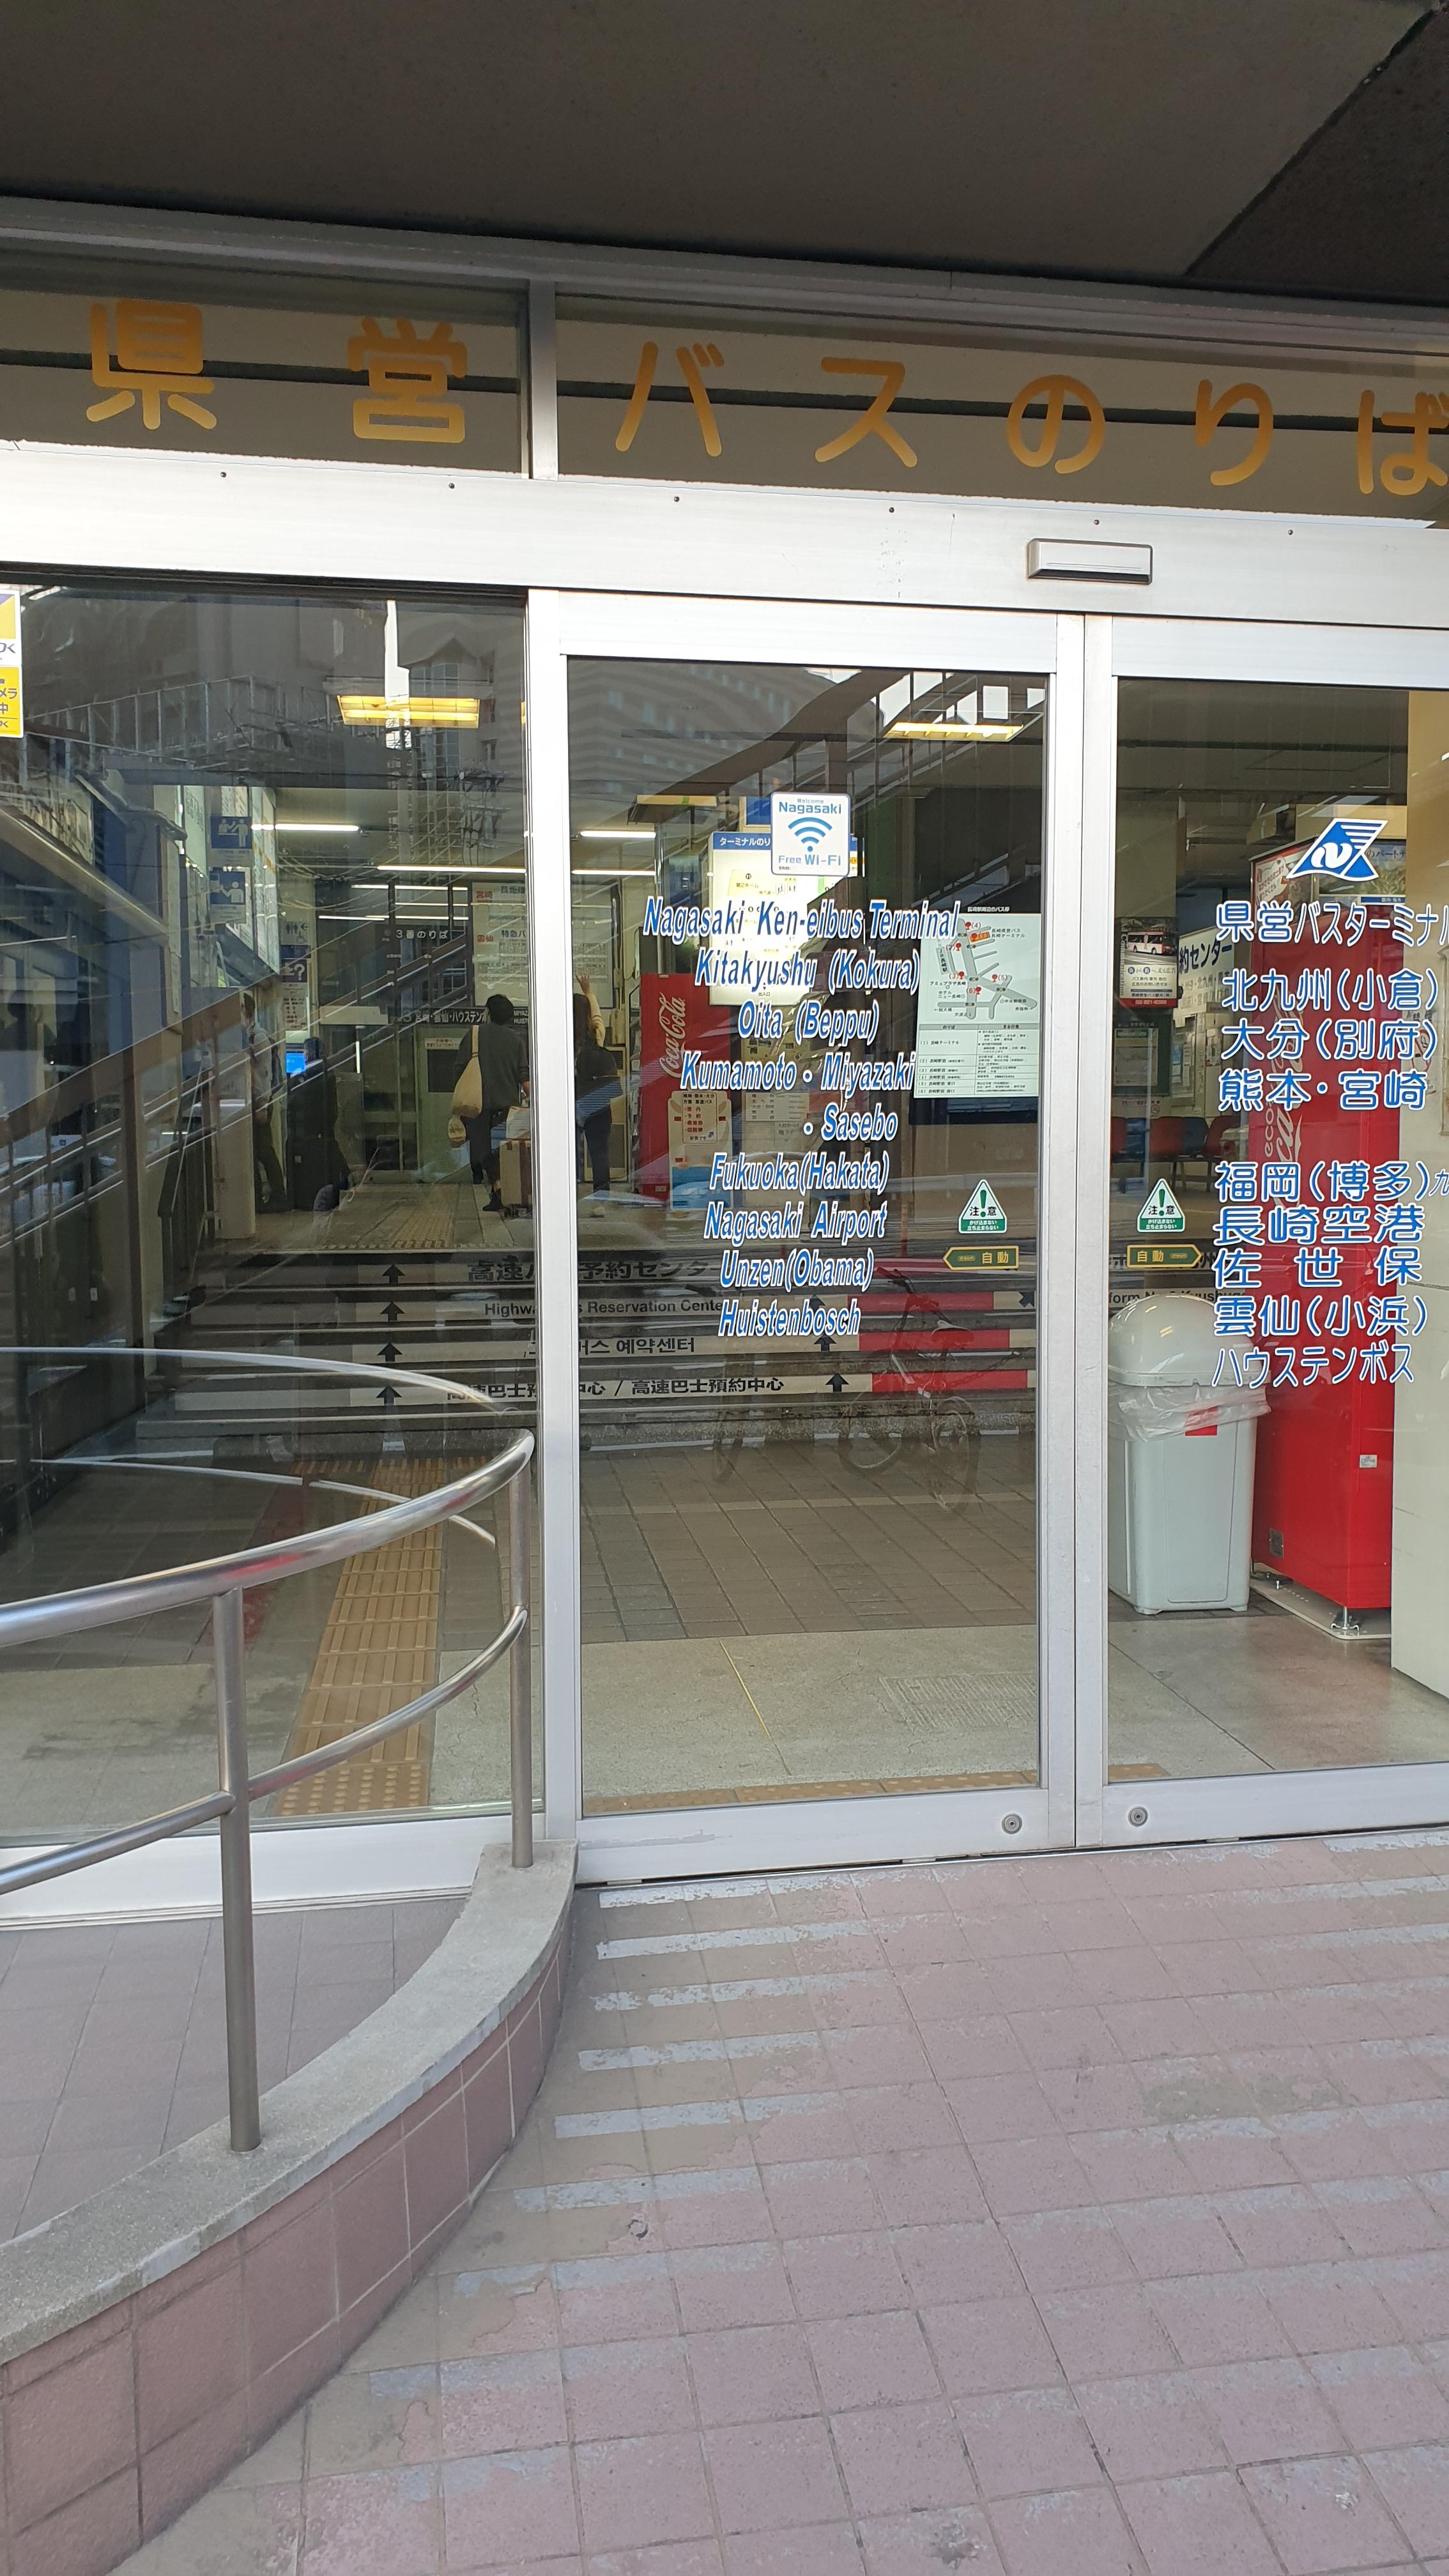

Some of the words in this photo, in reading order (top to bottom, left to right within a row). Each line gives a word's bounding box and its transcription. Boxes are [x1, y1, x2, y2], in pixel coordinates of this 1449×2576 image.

[778, 801, 842, 815] Nagasaki
[778, 855, 802, 864] Free
[804, 854, 841, 866] Wi-Fi
[643, 896, 744, 943] Nagasaki
[757, 898, 862, 938] Ken-eibus
[869, 900, 960, 939] Terminal
[695, 947, 816, 993] Kitakyushu
[829, 949, 920, 993] (Kokura)
[659, 992, 686, 1078] Coca-Cola
[737, 999, 783, 1039] Oita
[795, 1000, 880, 1046] (Beppu)
[680, 1051, 797, 1090] Kumamoto
[820, 1052, 916, 1098] Miyazaki
[1218, 1068, 1427, 1112] 熊本・宮崎
[821, 1103, 898, 1141] Sasebo
[709, 1152, 889, 1197] Fukuoka(Hakata)
[703, 1201, 803, 1247] Nagasaki
[811, 1200, 887, 1245] Airport
[969, 1206, 997, 1216] 注意
[1148, 1205, 1175, 1215] 注意
[1213, 1204, 1425, 1246] 長崎空港
[720, 1248, 874, 1292] Unzen(Obama)
[982, 1252, 1009, 1264] 自動
[1137, 1250, 1163, 1262] 自動
[587, 1300, 677, 1314] Reservation
[680, 1298, 723, 1311] Cente
[717, 1298, 861, 1337] Huistenbosch
[616, 1337, 694, 1354] 예약센터
[1211, 1340, 1414, 1388] ハウステンボス
[631, 1376, 785, 1395] 高速巴士預約中心
